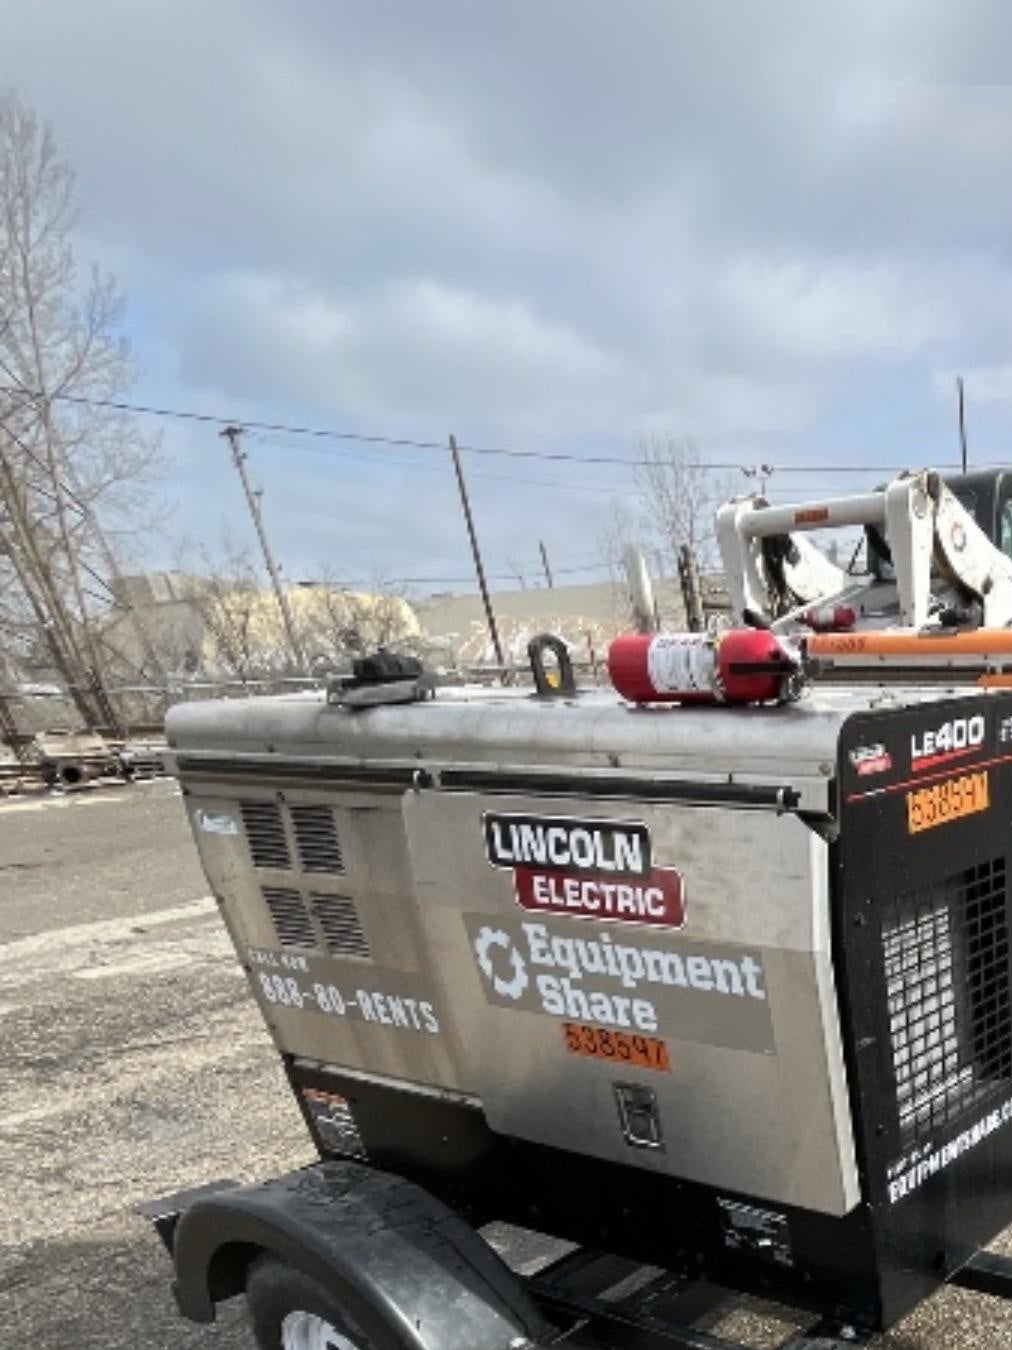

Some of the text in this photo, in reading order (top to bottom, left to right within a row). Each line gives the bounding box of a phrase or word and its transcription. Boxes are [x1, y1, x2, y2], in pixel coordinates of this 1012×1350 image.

[911, 715, 985, 760] LE400
[491, 822, 643, 873] LINCOLN
[532, 876, 666, 917] ELECTRIC
[522, 922, 766, 999] Equipment
[258, 972, 440, 1034] 888-80-RENTS
[536, 973, 659, 1032] Share
